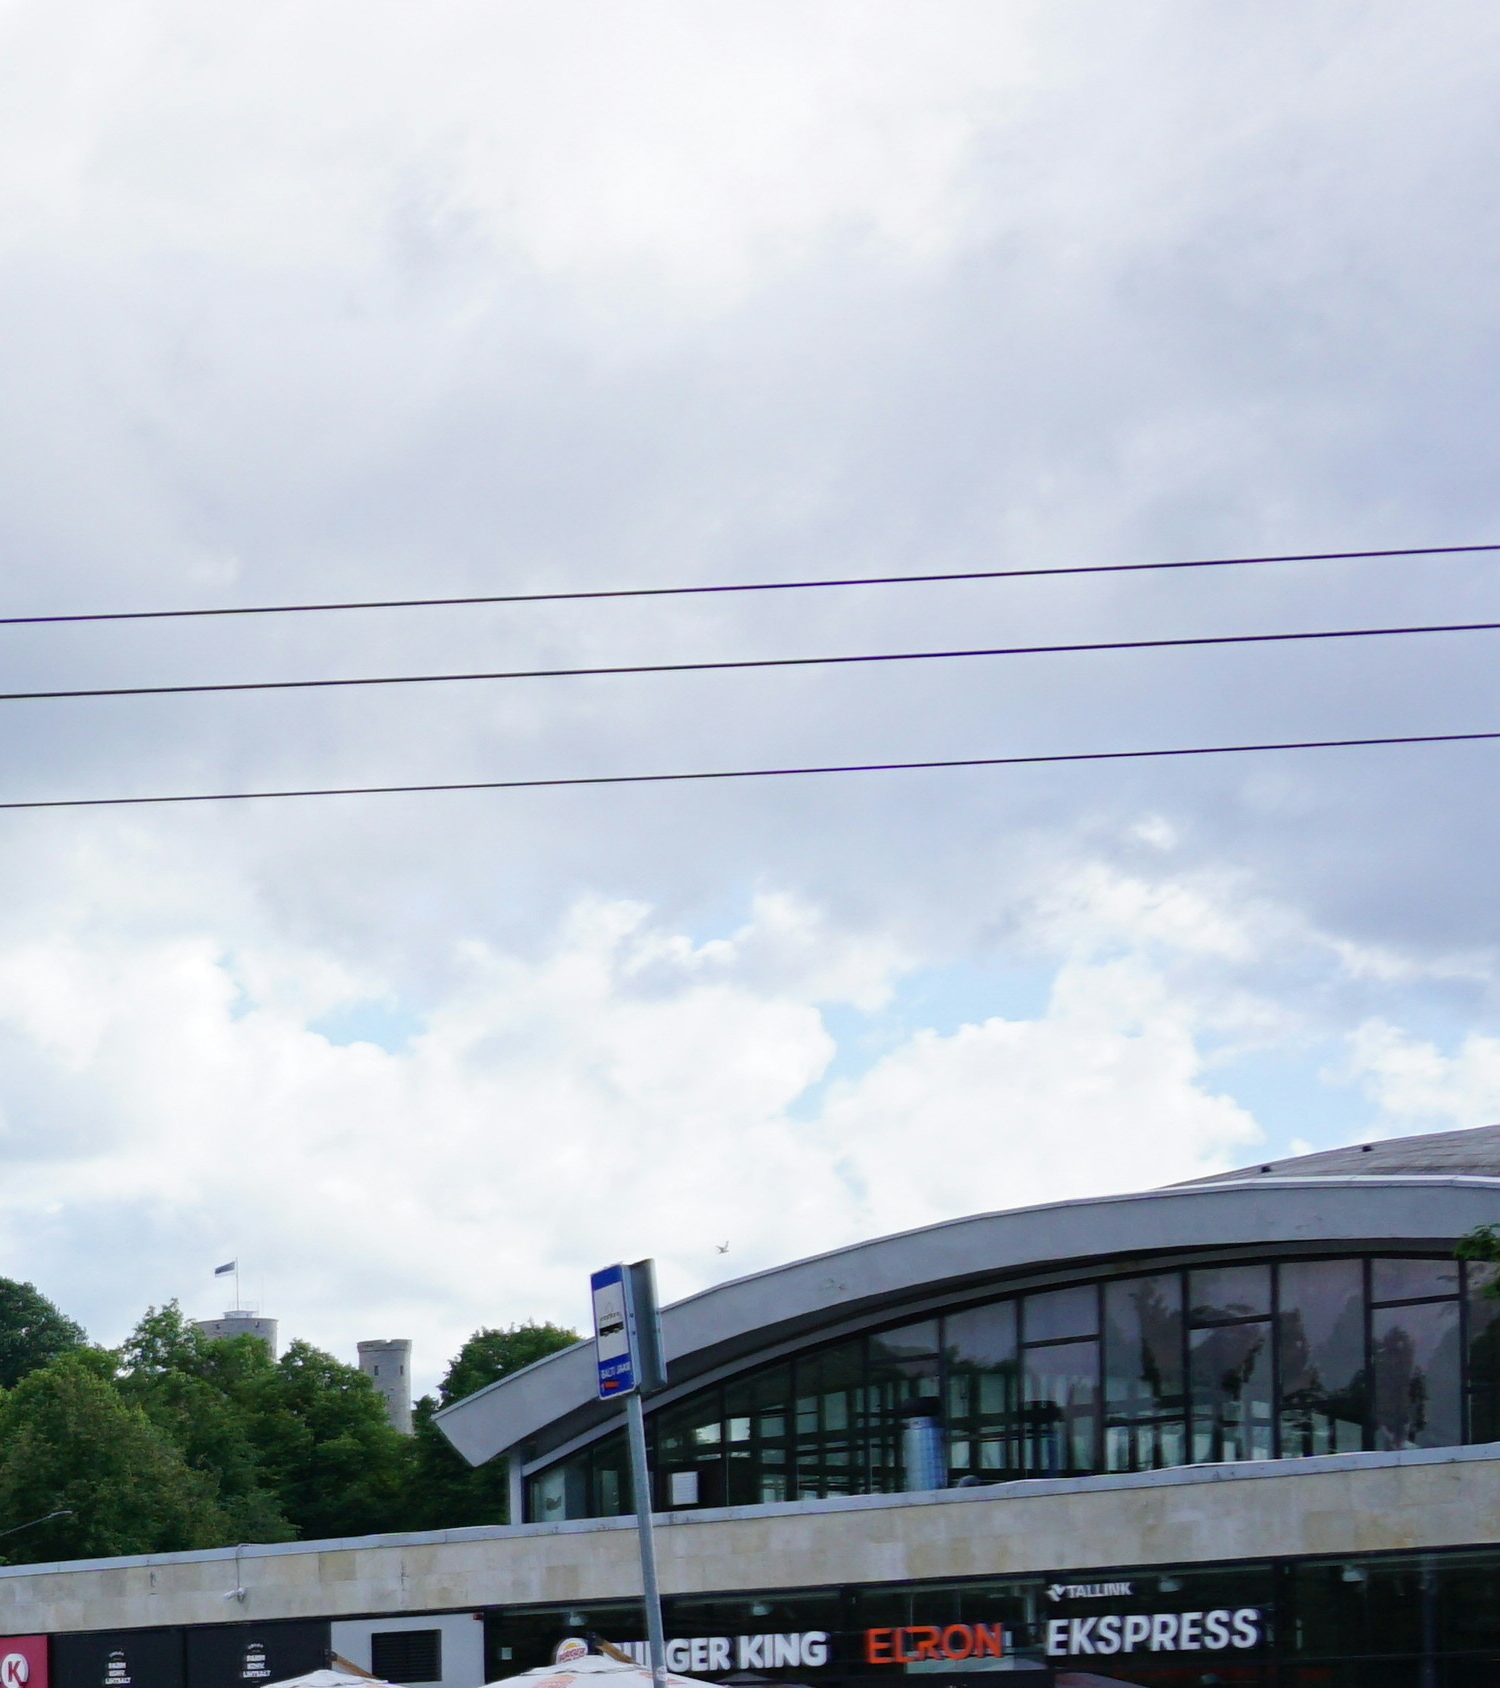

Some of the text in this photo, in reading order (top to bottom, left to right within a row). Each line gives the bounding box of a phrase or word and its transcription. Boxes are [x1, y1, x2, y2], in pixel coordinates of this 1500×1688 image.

[1066, 1582, 1132, 1598] TALLINK
[739, 1631, 828, 1670] KING
[866, 1623, 1002, 1663] ELRON
[1047, 1608, 1258, 1656] EKSPRESS
[5, 1659, 24, 1688] K
